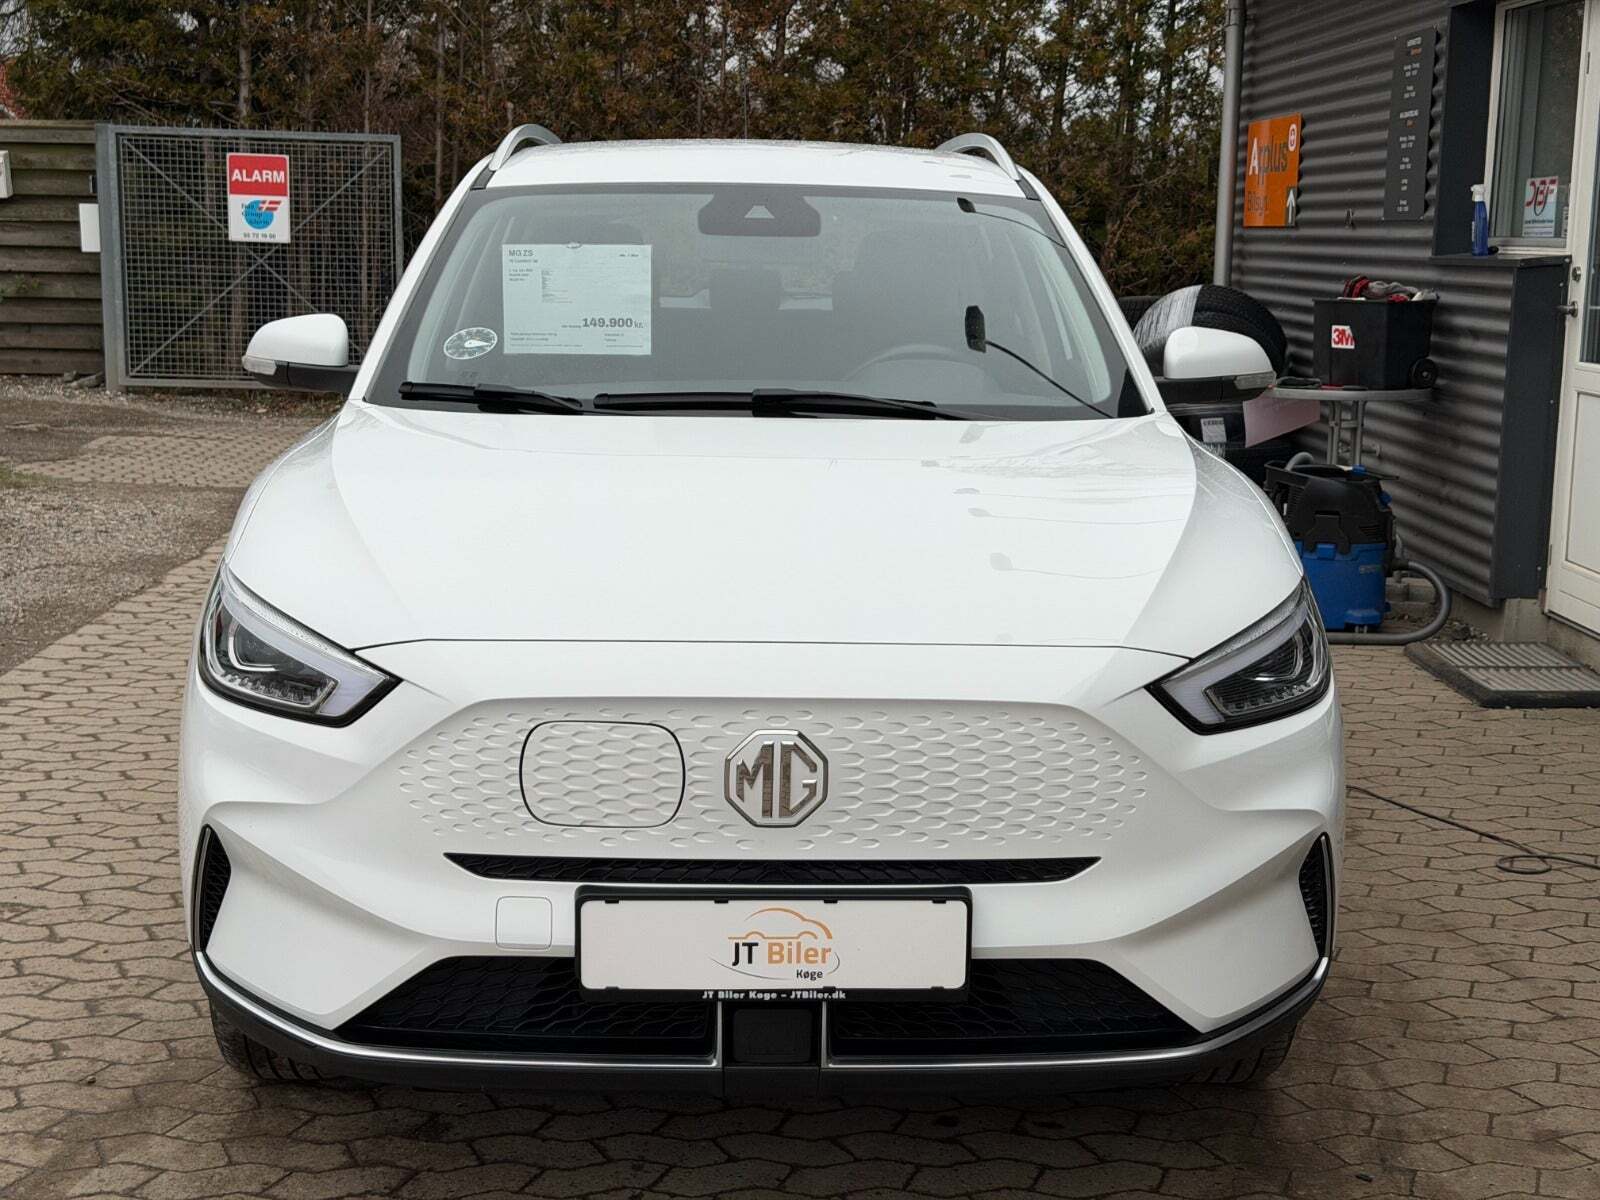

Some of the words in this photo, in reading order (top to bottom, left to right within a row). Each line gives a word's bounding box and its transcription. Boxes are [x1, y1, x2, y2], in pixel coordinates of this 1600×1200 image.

[231, 169, 285, 184] ALARM
[523, 249, 534, 257] ZS
[582, 317, 633, 328] 149.900
[1333, 328, 1356, 346] 3M
[735, 740, 818, 818] MG
[732, 942, 759, 967] JT
[767, 941, 832, 965] Biler
[796, 968, 824, 981] Køge
[702, 990, 715, 999] JT
[718, 990, 745, 999] Biler
[789, 990, 846, 999] JTBiler.dk
